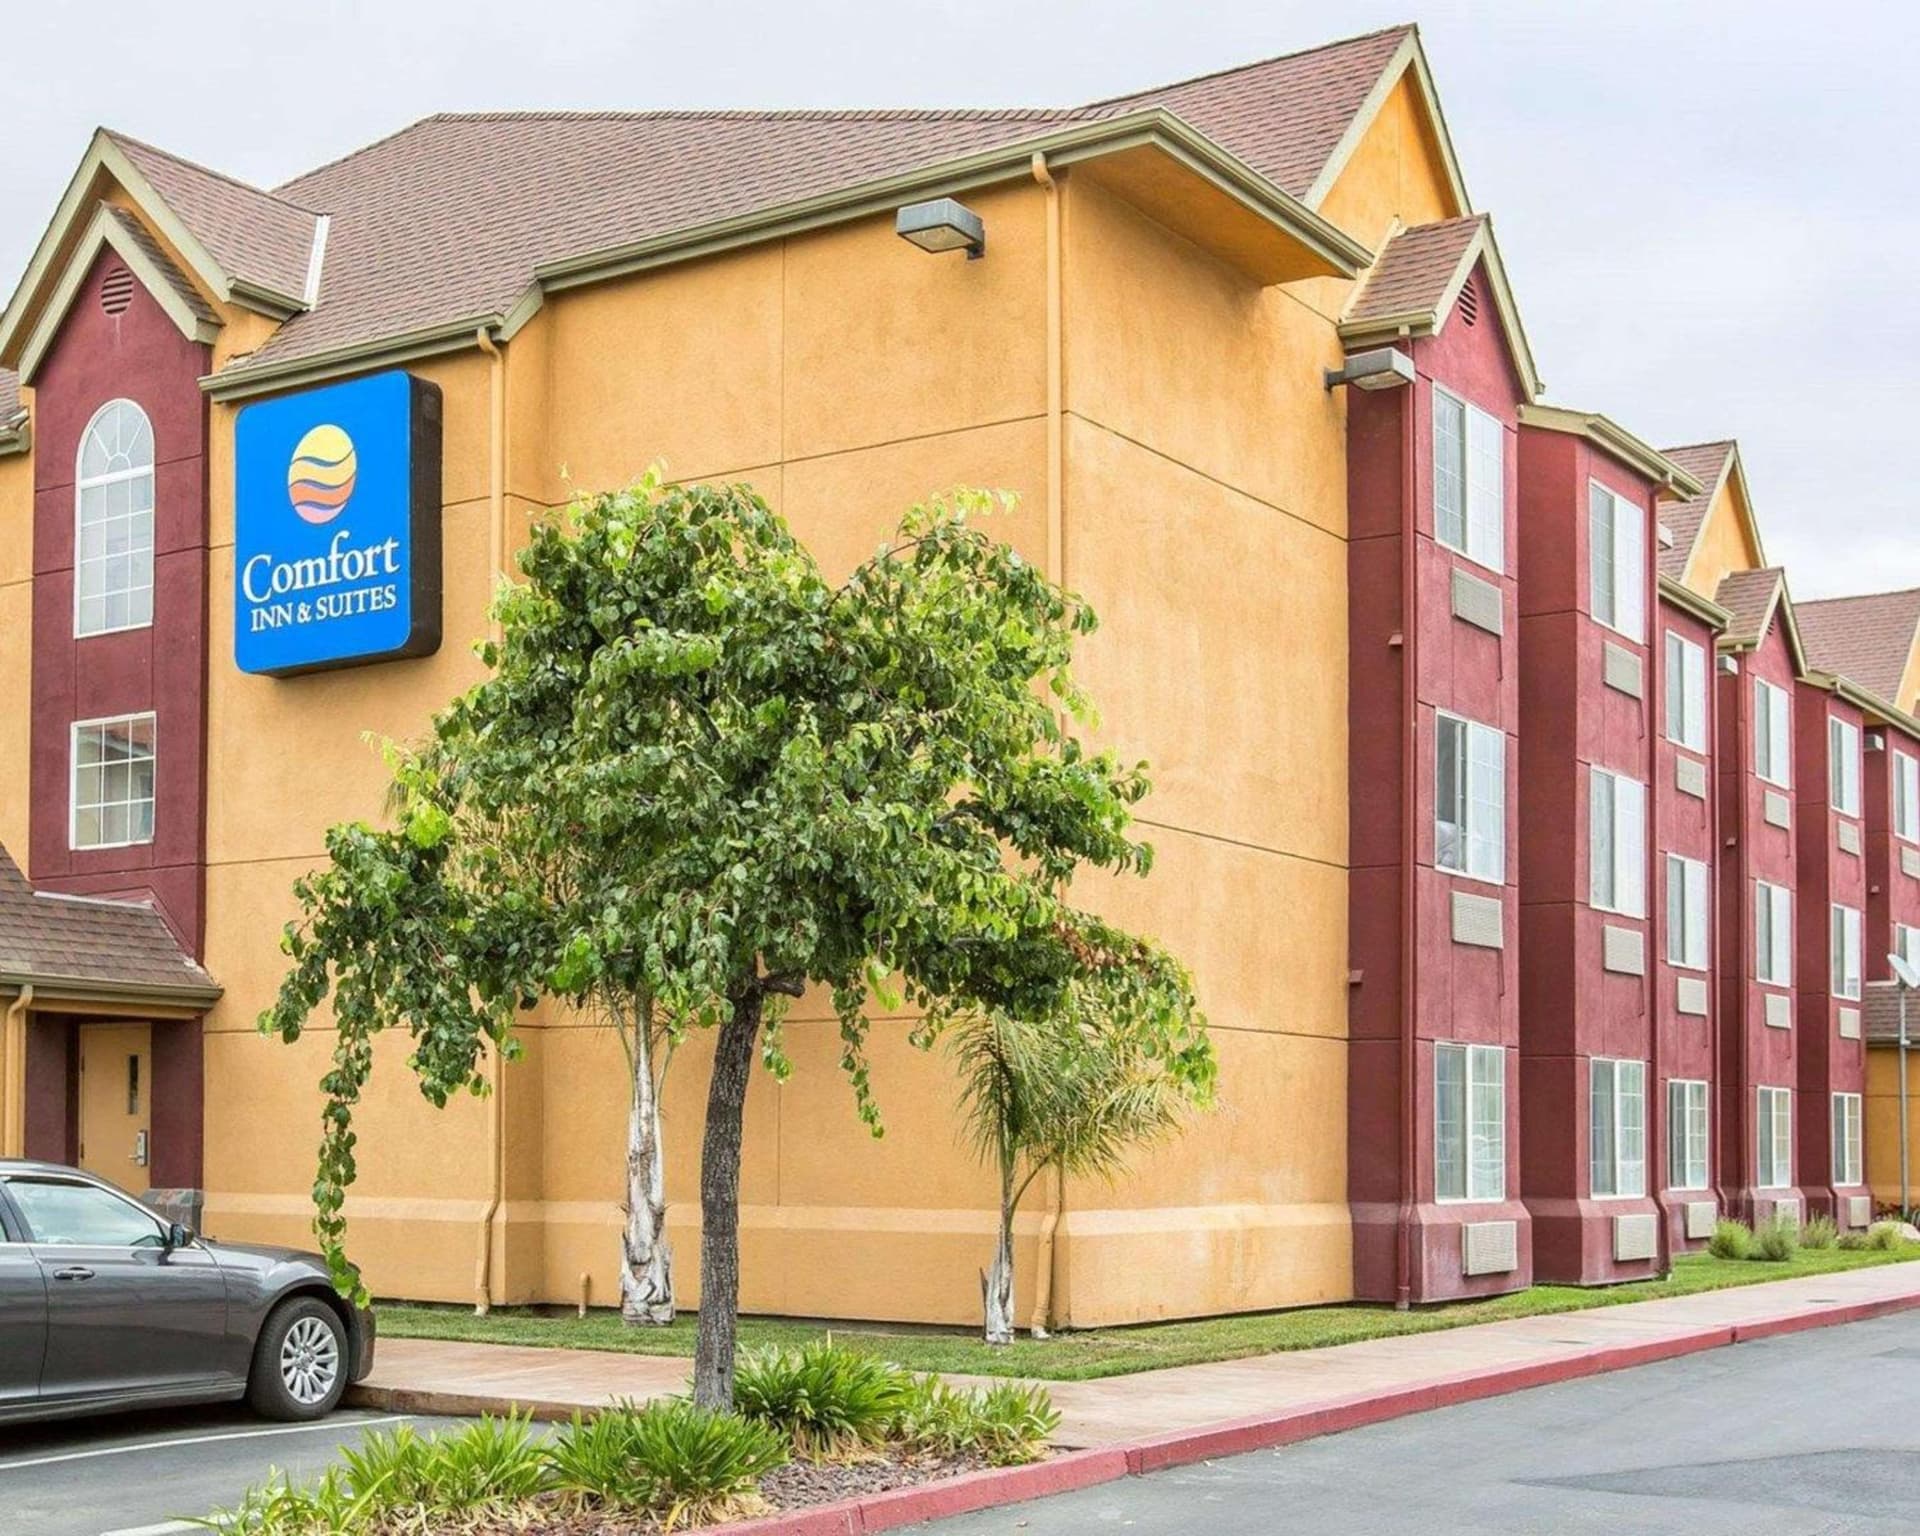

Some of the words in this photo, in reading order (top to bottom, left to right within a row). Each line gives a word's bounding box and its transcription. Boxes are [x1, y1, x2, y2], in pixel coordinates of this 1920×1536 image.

[242, 530, 400, 603] Comfort
[250, 603, 292, 632] INN
[297, 602, 312, 623] &
[316, 584, 397, 620] SUITES
